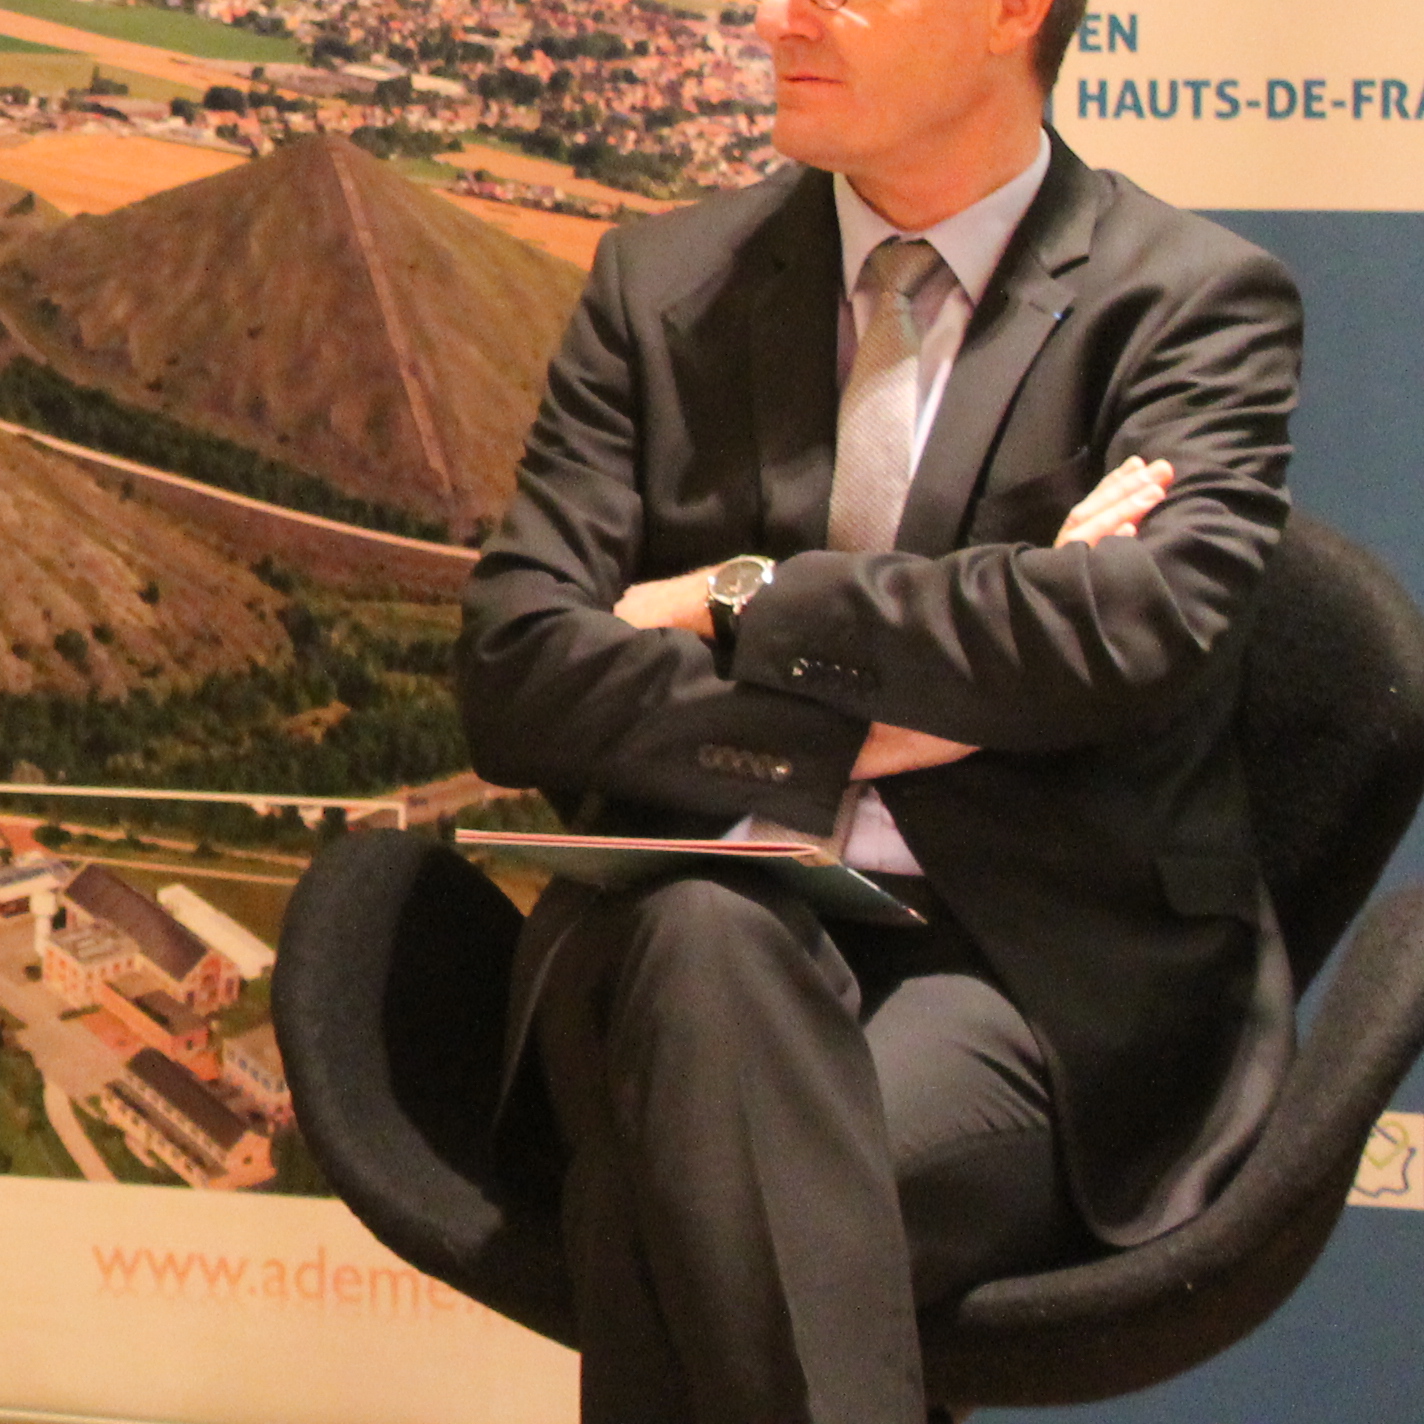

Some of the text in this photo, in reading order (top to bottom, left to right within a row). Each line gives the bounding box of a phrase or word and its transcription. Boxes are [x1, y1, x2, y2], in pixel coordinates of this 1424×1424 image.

[1077, 13, 1139, 53] EN
[1077, 78, 1424, 120] HAUTS-DE-FR
[92, 1244, 482, 1318] www.ademe.
